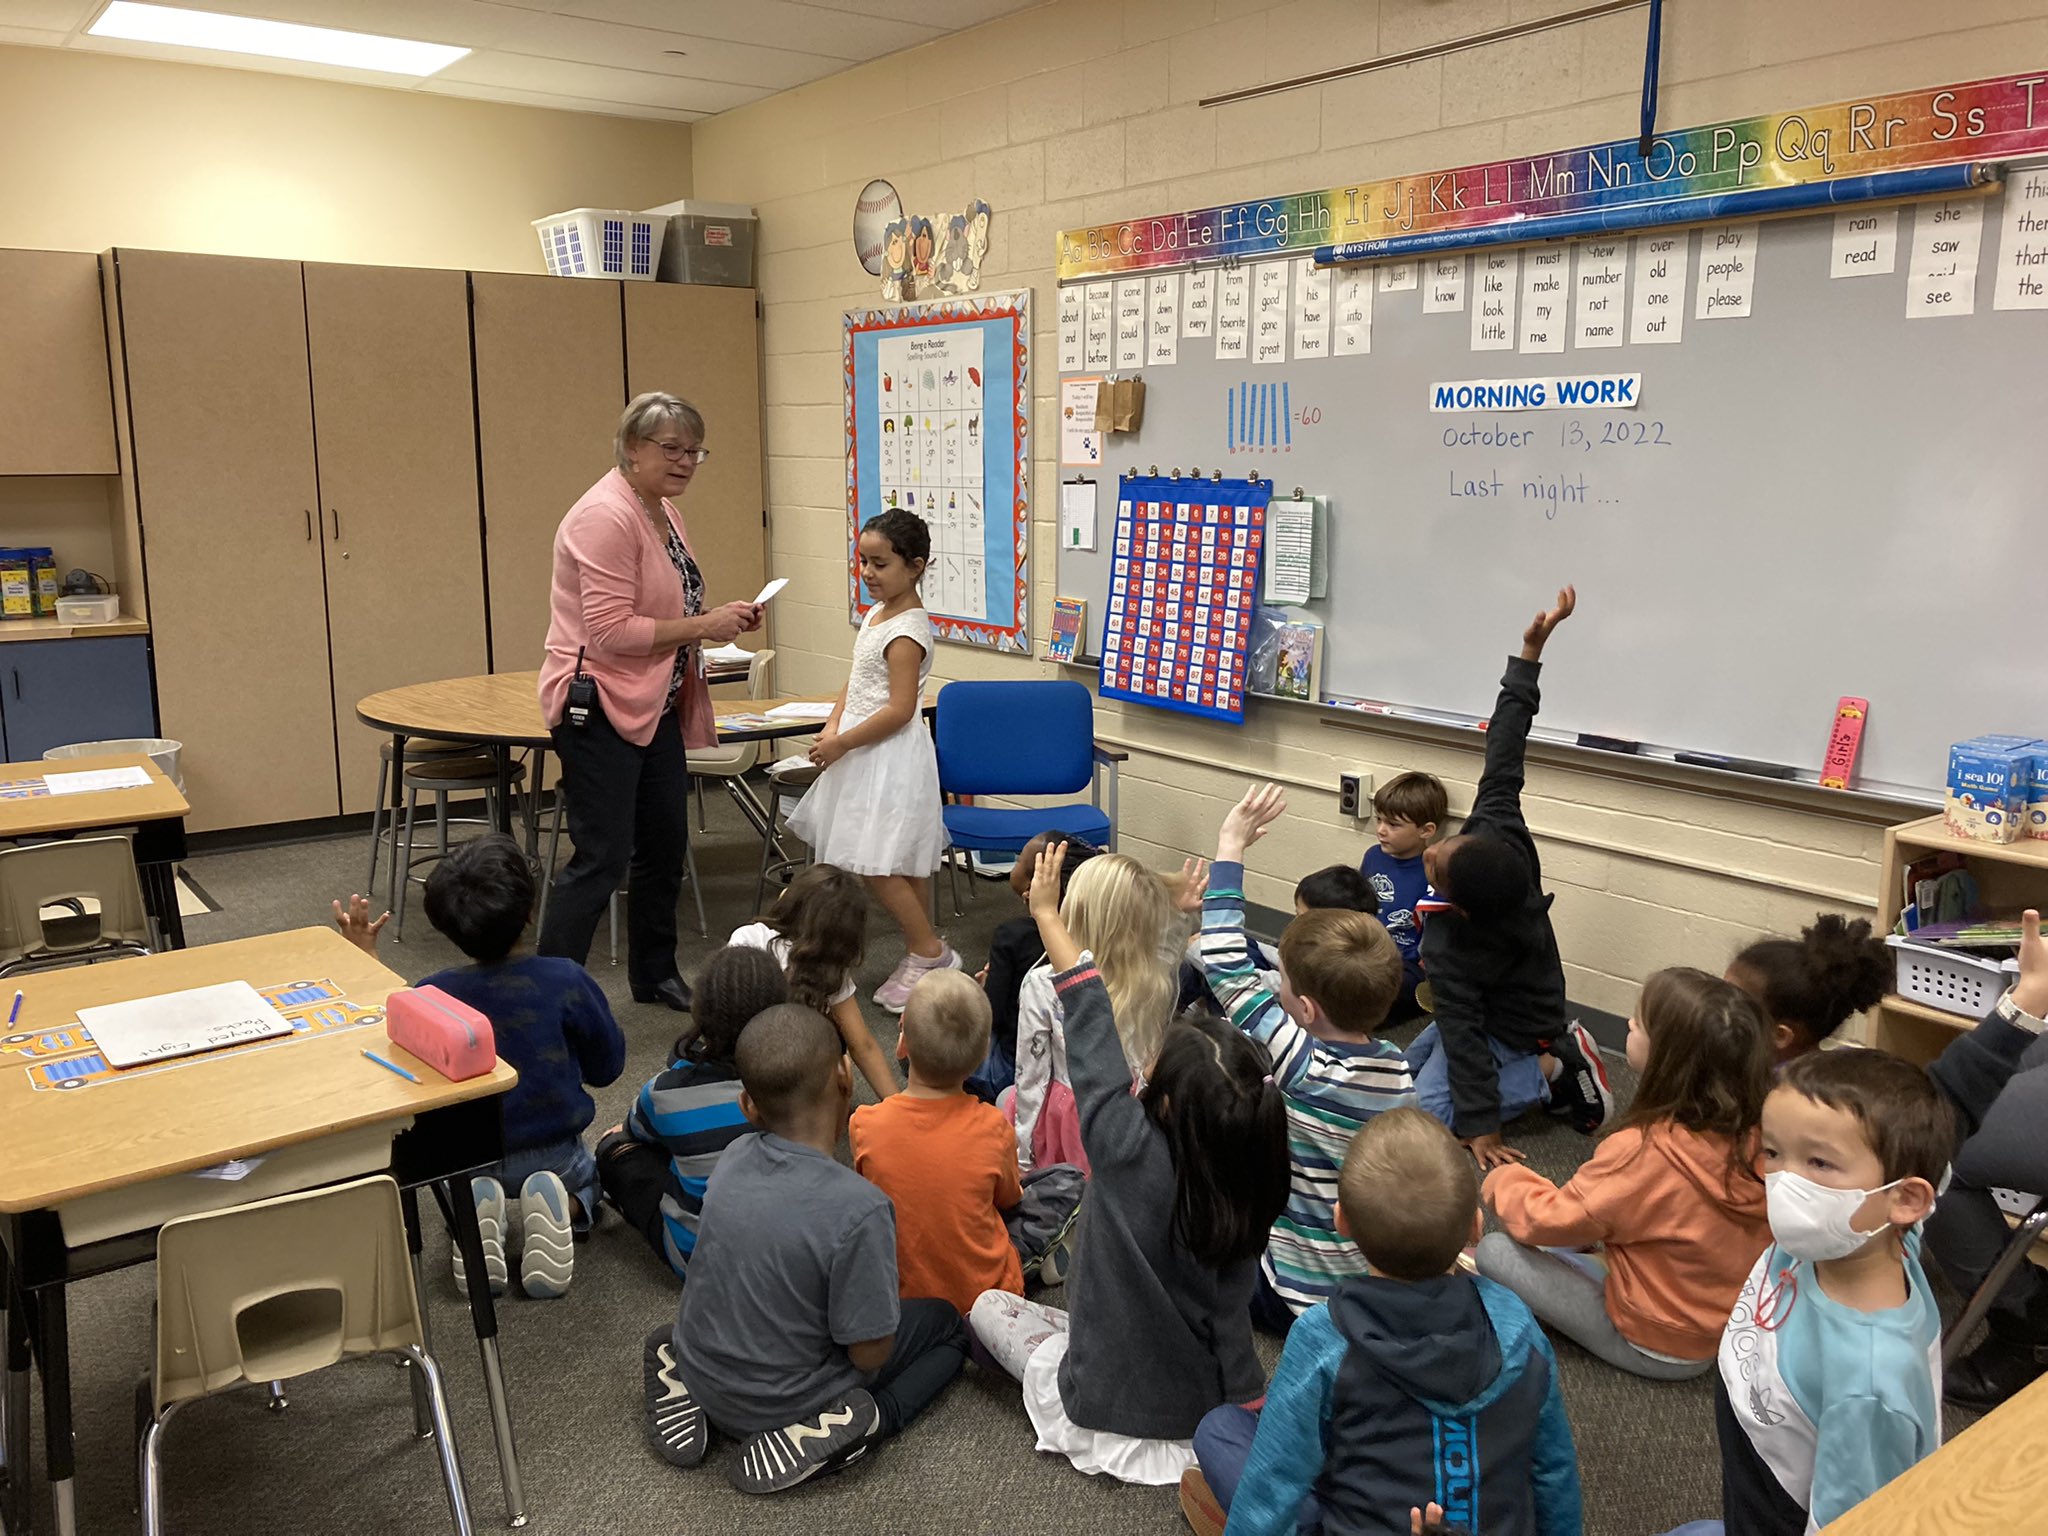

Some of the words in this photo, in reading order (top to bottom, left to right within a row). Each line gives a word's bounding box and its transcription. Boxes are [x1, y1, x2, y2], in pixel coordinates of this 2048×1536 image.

[1060, 234, 1081, 265] Aa
[1087, 229, 1111, 260] Bb
[1117, 226, 1144, 255] Cc
[1151, 218, 1178, 251] Dd
[1186, 215, 1212, 247] Ee
[1220, 204, 1248, 242] Ff
[1256, 204, 1289, 247] Gg
[1298, 196, 1331, 231] Hh
[1344, 189, 1369, 226] Ii
[1383, 181, 1415, 231] Jj
[1429, 173, 1467, 214] Kk
[1484, 164, 1512, 206] Ll
[1529, 157, 1576, 201] Mm
[1587, 149, 1631, 190] Nn
[1644, 139, 1697, 180] Oo
[1712, 127, 1761, 185] Pp
[1775, 116, 1835, 174] Qq
[1849, 104, 1905, 153] Rr
[1931, 92, 1986, 141] Ss
[2016, 78, 2046, 129] T
[1934, 202, 1961, 223] she
[1849, 216, 1877, 232] rain
[1716, 226, 1742, 250] play
[1346, 240, 1389, 254] NYSTROM
[1593, 247, 1615, 258] new
[1650, 241, 1675, 252] over
[1845, 240, 1877, 264] read
[1932, 241, 1960, 254] saw
[1488, 253, 1506, 270] love
[1536, 250, 1562, 265] must
[2015, 243, 2048, 266] that
[1437, 260, 1458, 280] keep
[1582, 266, 1622, 286] number
[1650, 259, 1666, 278] old
[1706, 255, 1744, 283] people
[1192, 274, 1205, 289] end
[1226, 271, 1243, 285] from
[1263, 271, 1278, 287] give
[1388, 267, 1407, 288] just
[1484, 275, 1503, 292] like
[1533, 274, 1560, 293] make
[2018, 273, 2043, 296] the
[1155, 280, 1167, 294] did
[1306, 286, 1319, 301] his
[1350, 284, 1358, 299] if
[1435, 287, 1456, 302] know
[1192, 295, 1207, 309] each
[1226, 292, 1240, 306] find
[1262, 290, 1280, 312] good
[1589, 296, 1609, 311] not
[1647, 294, 1669, 305] one
[1707, 288, 1743, 314] please
[1925, 291, 1952, 304] see
[1304, 308, 1320, 322] have
[1347, 309, 1362, 322] into
[1483, 300, 1504, 316] look
[1537, 306, 1552, 320] my
[1155, 321, 1171, 335] Dear
[1189, 320, 1207, 333] every
[1481, 323, 1506, 340] little
[1585, 326, 1614, 337] name
[1646, 316, 1667, 332] out
[1121, 325, 1138, 339] could
[1530, 333, 1547, 343] me
[1221, 336, 1241, 350] friend
[1302, 335, 1320, 349] here
[1347, 336, 1355, 345] is
[1088, 349, 1108, 363] before
[1156, 344, 1171, 357] does
[1260, 341, 1280, 360] great
[1435, 383, 1546, 408] MORNING
[1556, 378, 1634, 404] WORK
[1443, 422, 1535, 448] October
[1600, 421, 1672, 446] 2022
[1450, 469, 1504, 497] Last
[1254, 512, 1262, 521] 10
[1250, 534, 1260, 543] 20
[1203, 550, 1211, 559] 27
[1201, 571, 1211, 580] 37
[1200, 591, 1209, 599] 47
[1195, 631, 1205, 639] 67
[1123, 639, 1131, 649] 72
[1136, 641, 1144, 650] 73
[1194, 651, 1202, 659] 77
[1831, 734, 1851, 766] Girl's
[1964, 773, 1984, 783] sea
[1990, 814, 1998, 823] 6
